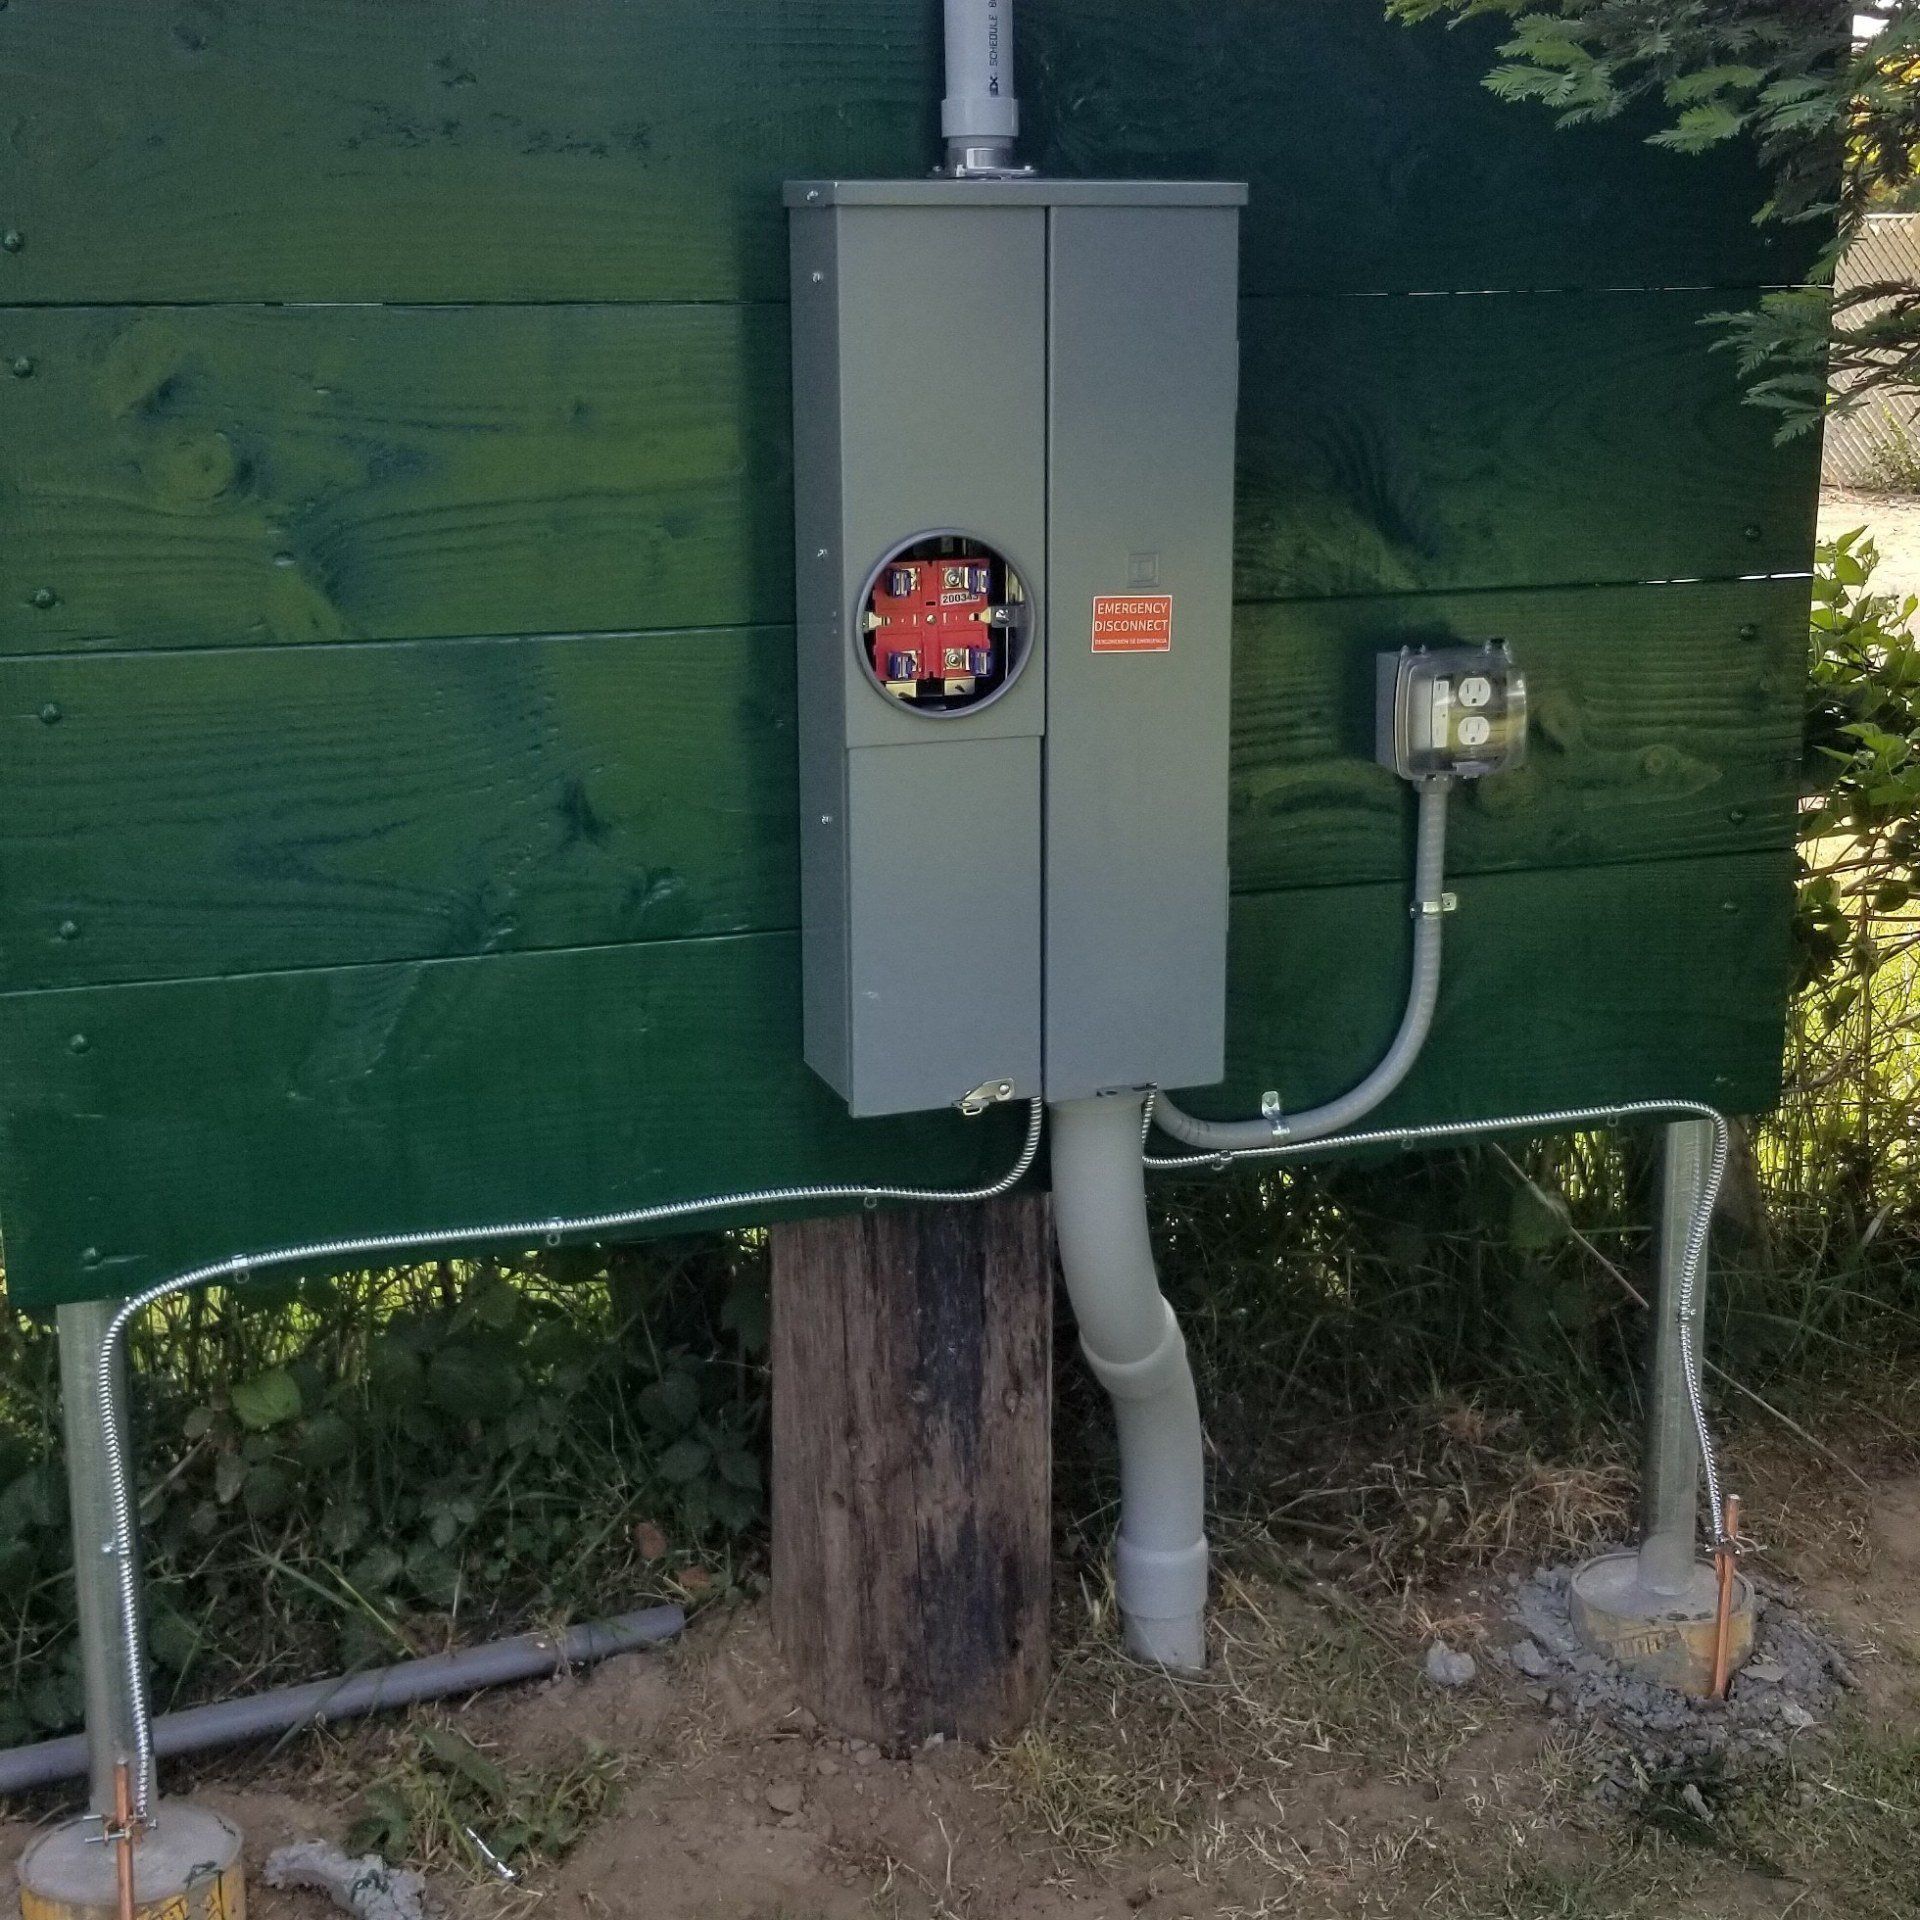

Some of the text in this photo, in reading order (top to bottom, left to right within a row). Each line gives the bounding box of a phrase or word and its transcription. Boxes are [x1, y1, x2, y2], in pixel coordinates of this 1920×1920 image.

[989, 14, 998, 67] SCHEDULE
[1097, 602, 1168, 615] EMERGENCY
[1094, 619, 1168, 632] DISCONNECT
